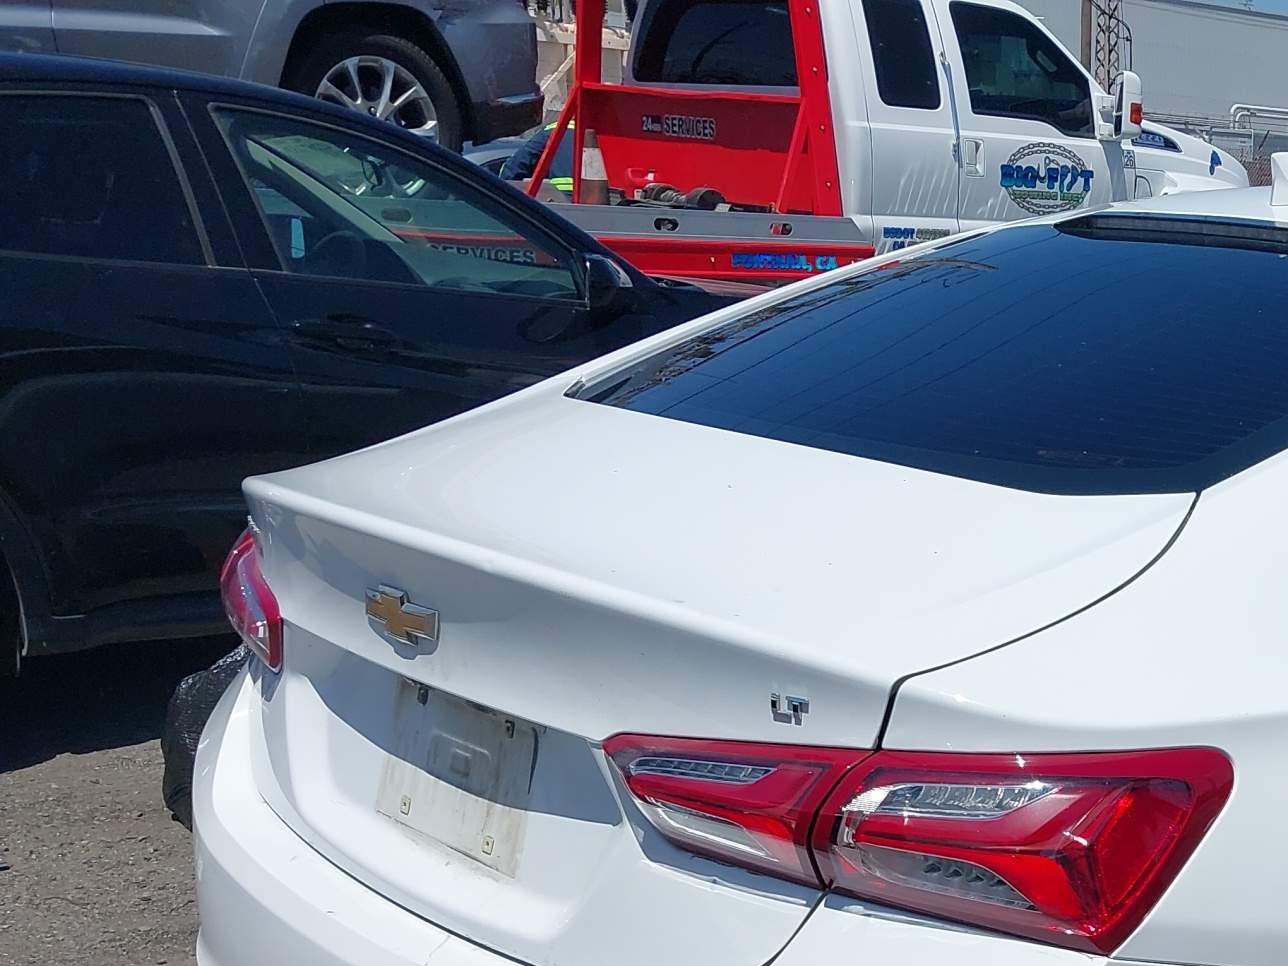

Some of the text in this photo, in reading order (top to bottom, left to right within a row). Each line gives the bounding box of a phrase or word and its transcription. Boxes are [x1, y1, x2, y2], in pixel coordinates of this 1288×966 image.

[663, 114, 717, 139] SERVICES
[1000, 164, 1037, 189] BIG
[815, 255, 838, 270] CA
[771, 693, 810, 726] LT
